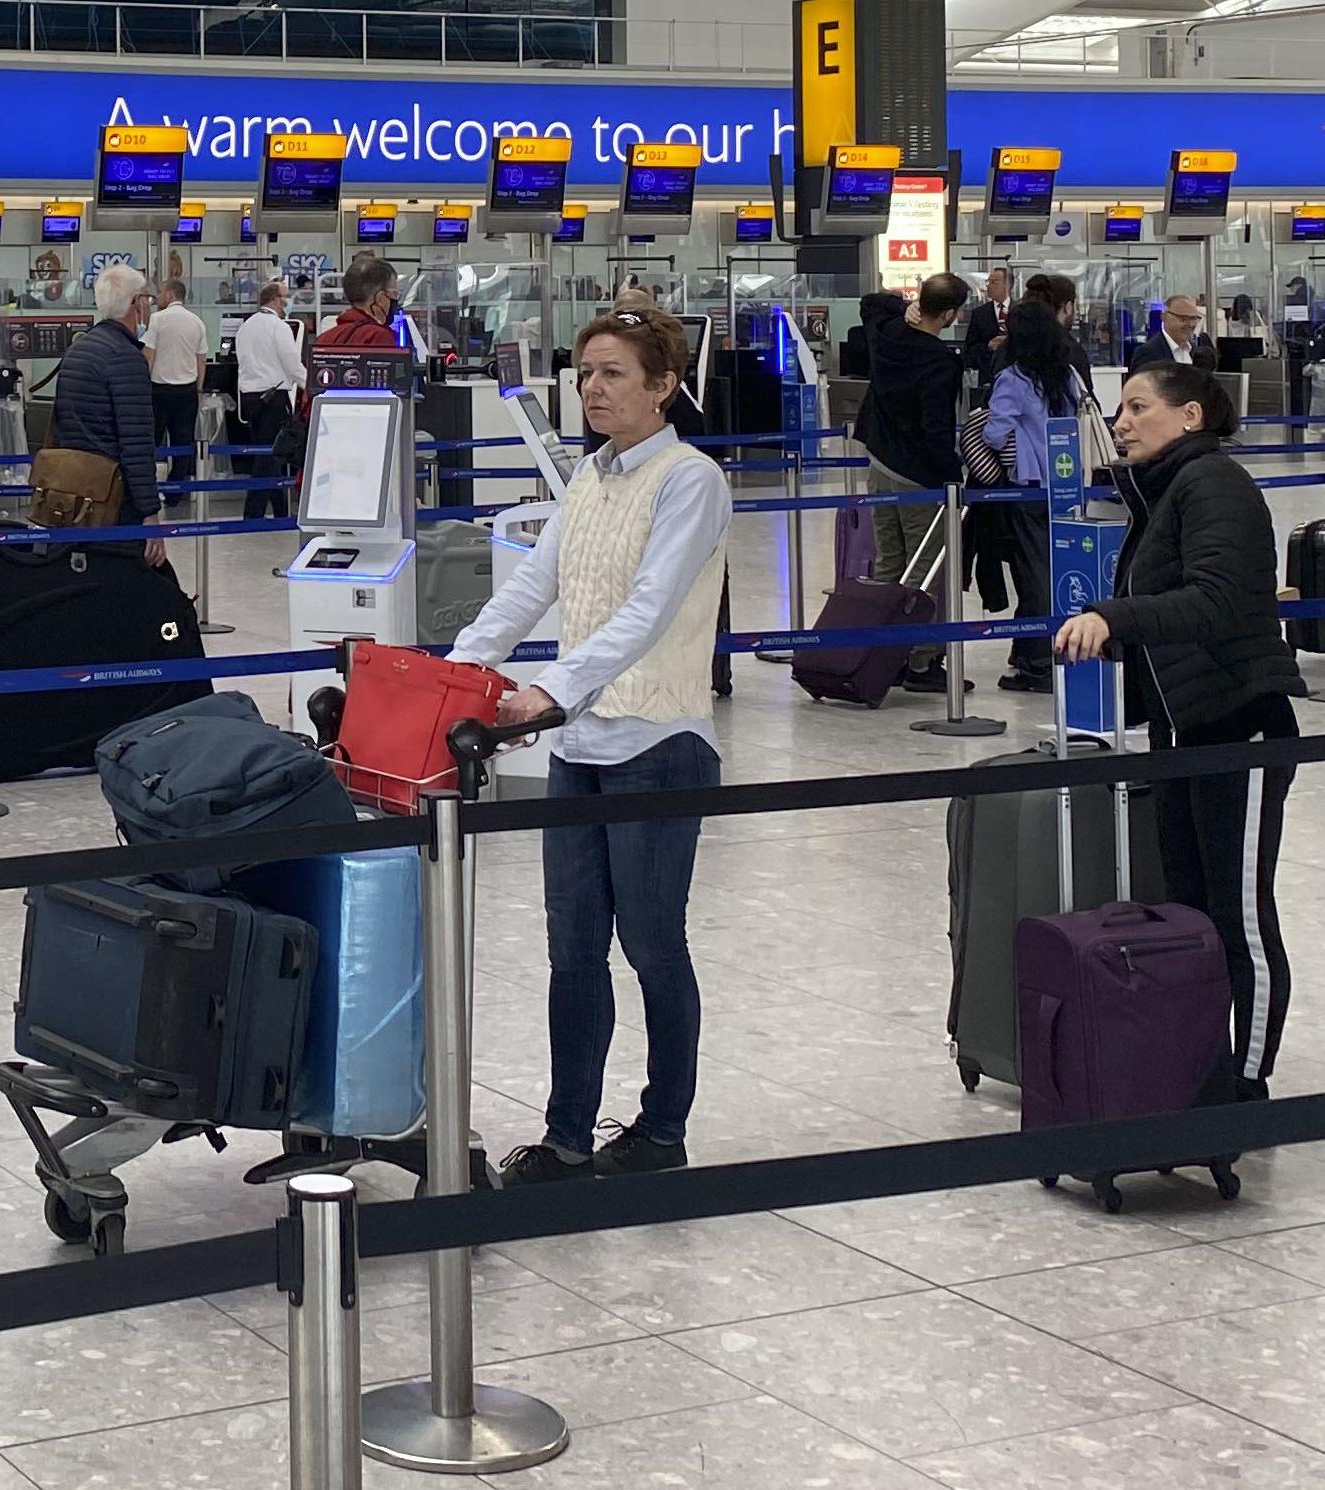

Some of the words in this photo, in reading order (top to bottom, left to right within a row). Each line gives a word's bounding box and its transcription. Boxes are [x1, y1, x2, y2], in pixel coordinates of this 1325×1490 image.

[818, 20, 840, 76] E
[107, 97, 134, 127] A
[591, 116, 645, 163] to
[123, 134, 147, 145] D10
[899, 243, 918, 258] A1
[516, 648, 545, 657] BRITISH
[93, 670, 127, 681] BRITISH
[127, 668, 163, 678] AIRWAYS
